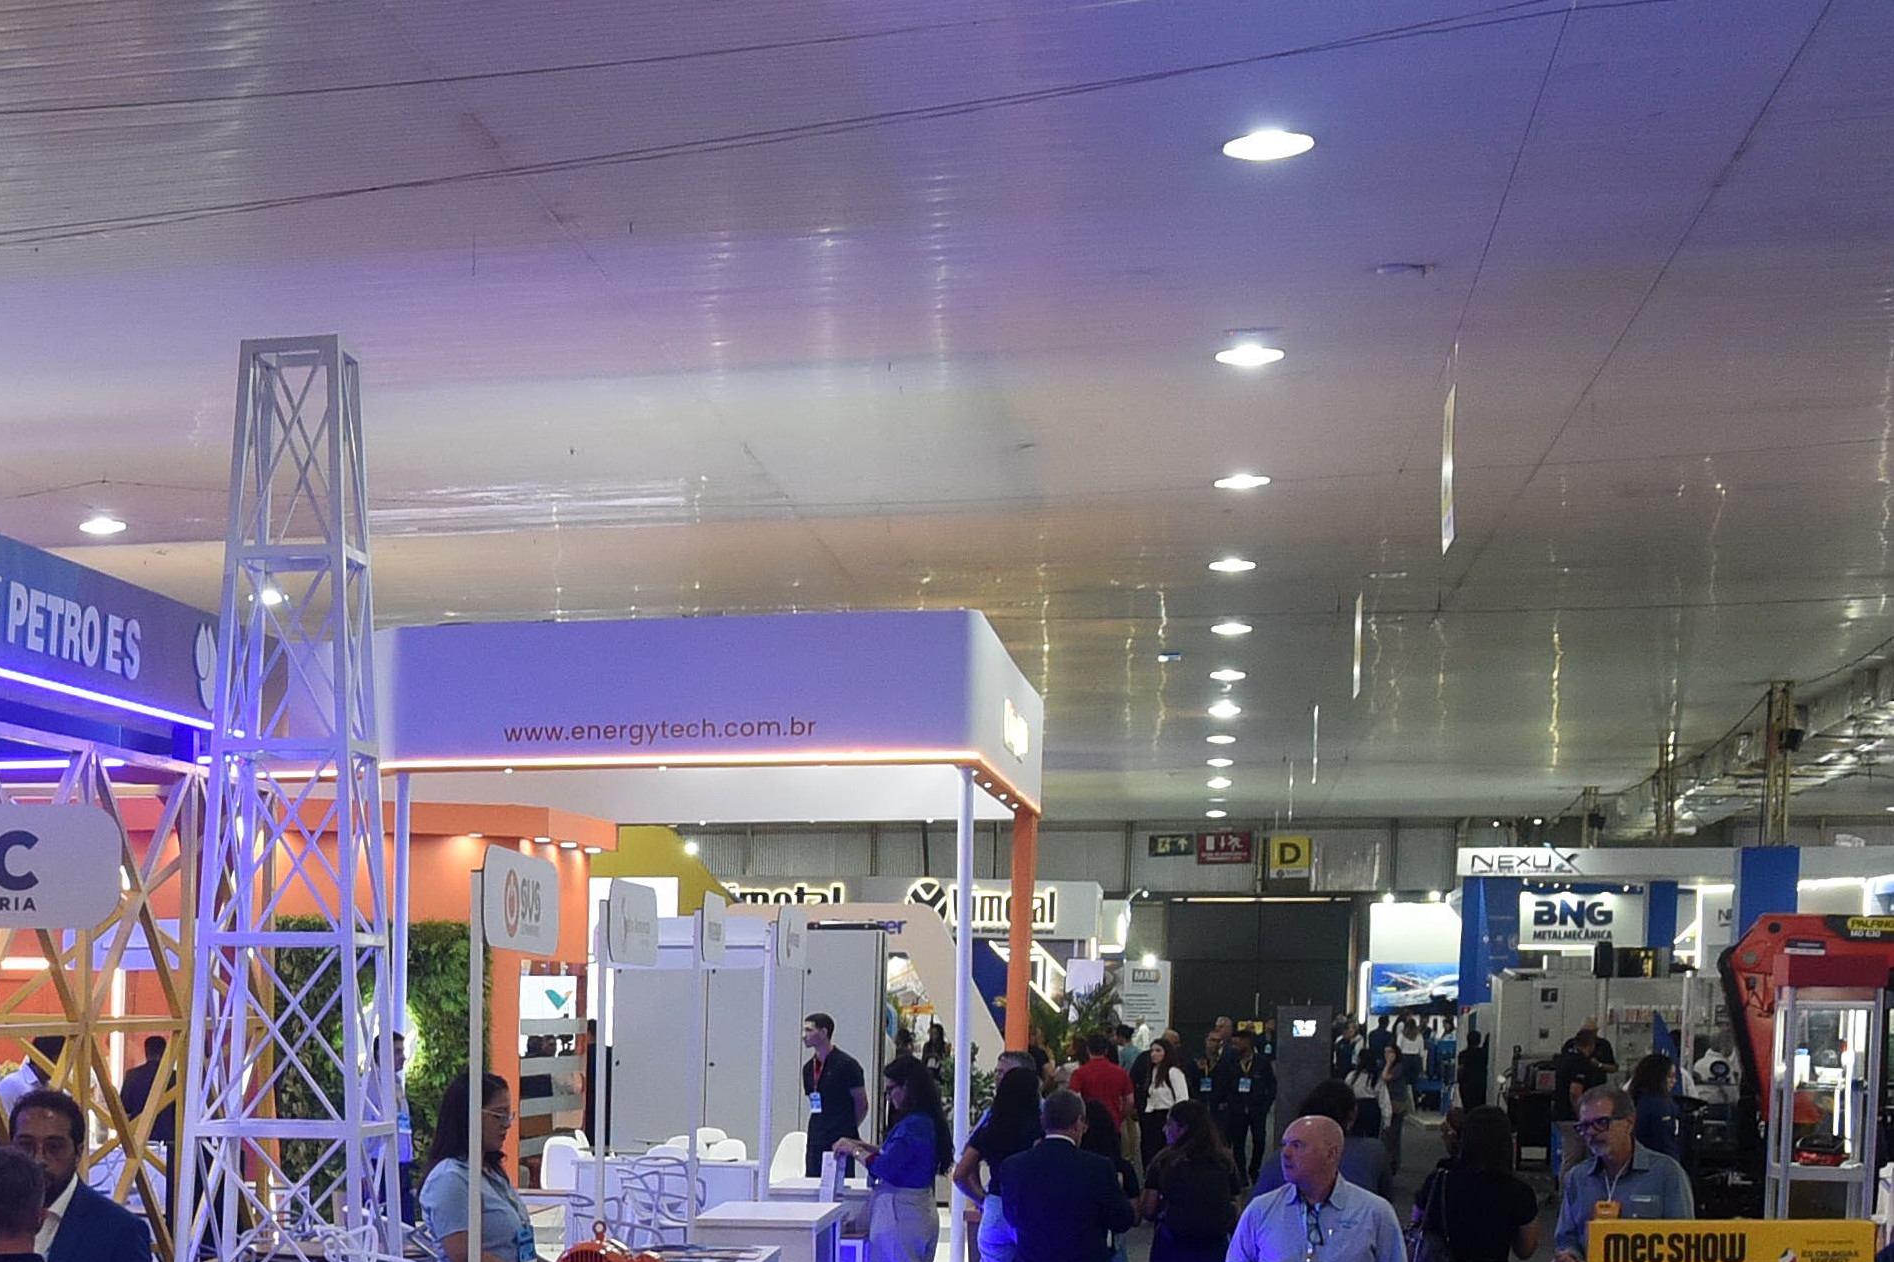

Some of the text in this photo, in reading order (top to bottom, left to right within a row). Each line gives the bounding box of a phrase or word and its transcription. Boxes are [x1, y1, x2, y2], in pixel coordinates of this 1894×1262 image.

[7, 580, 101, 668] PETRO
[104, 613, 142, 681] ES
[503, 717, 817, 746] www.energytech.com.br
[1279, 842, 1302, 865] D
[1533, 899, 1614, 928] BNG
